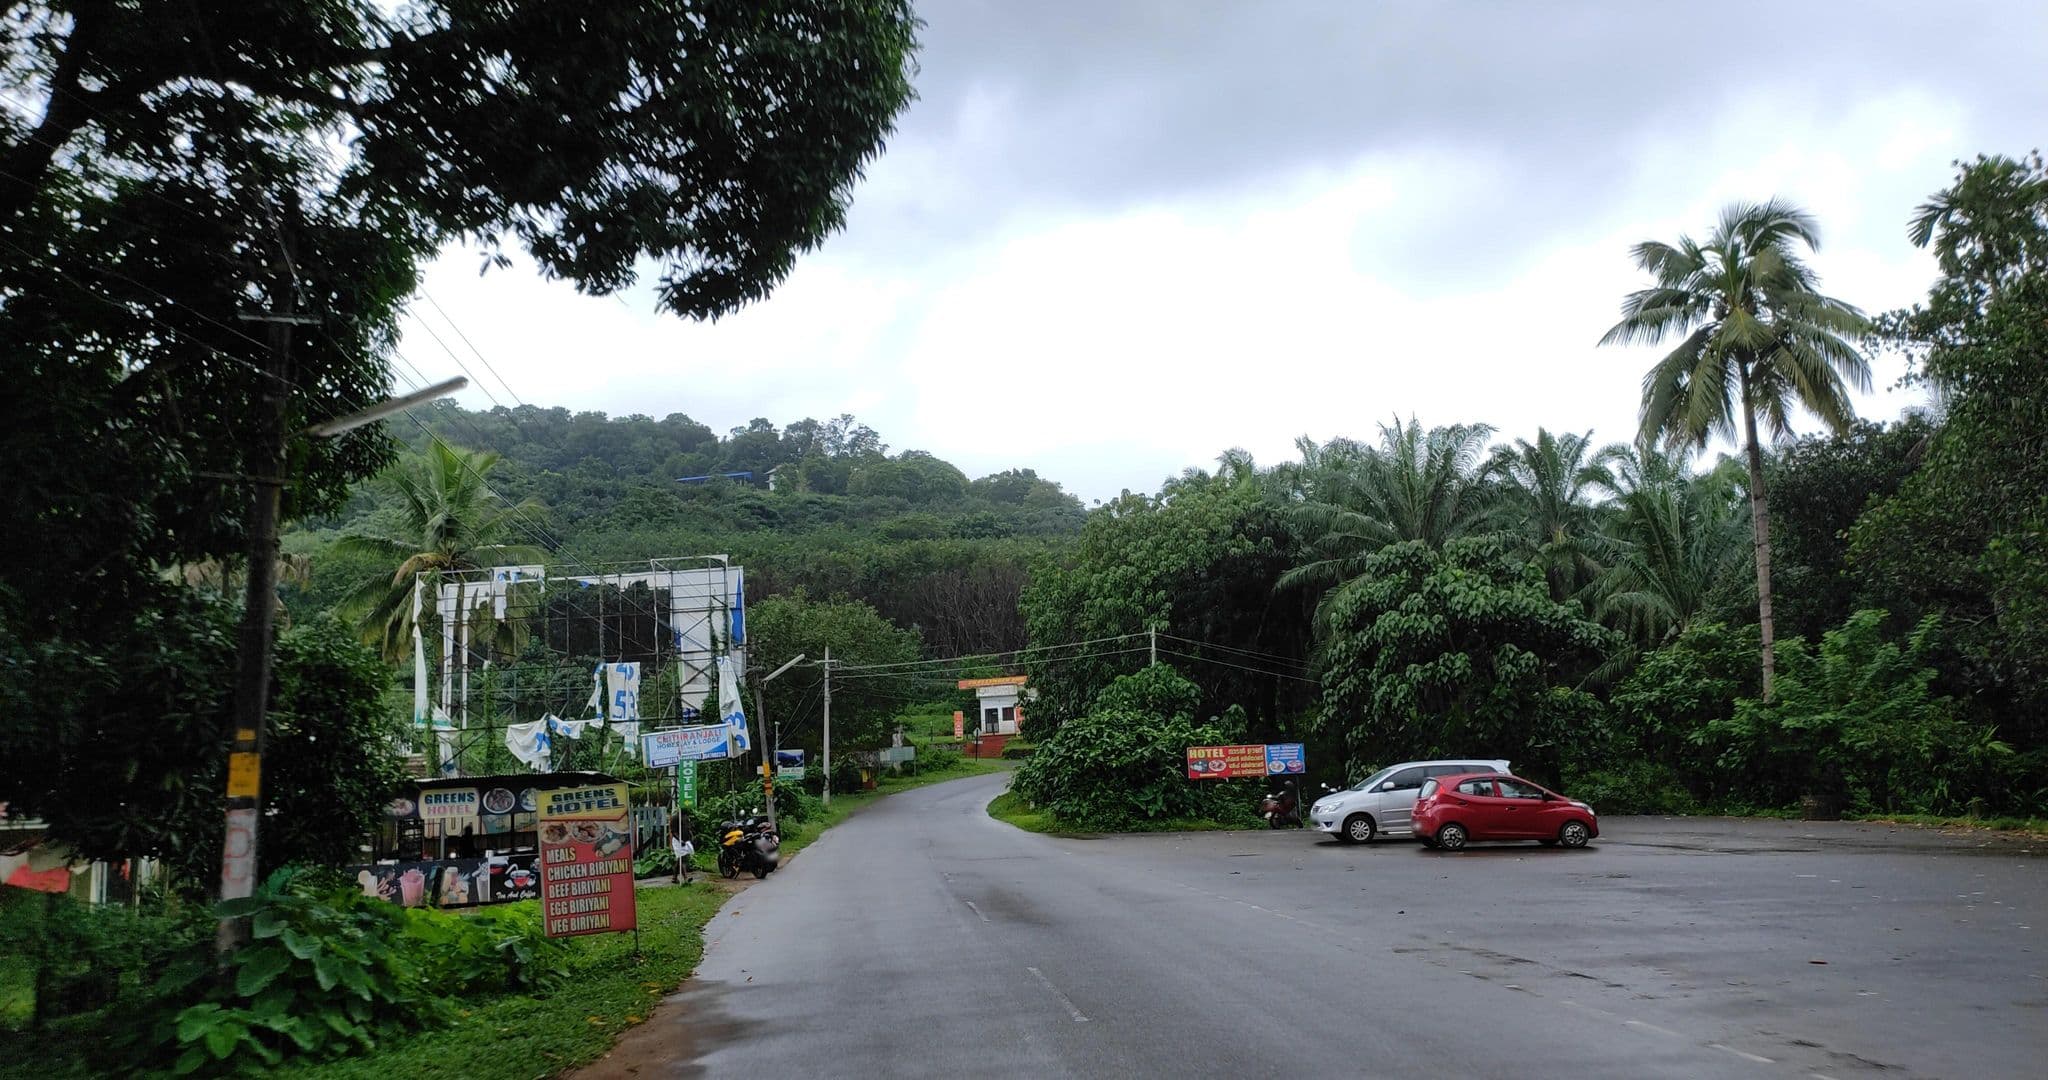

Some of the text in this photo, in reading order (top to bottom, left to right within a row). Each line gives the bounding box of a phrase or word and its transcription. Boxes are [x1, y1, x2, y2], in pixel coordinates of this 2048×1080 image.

[698, 736, 720, 745] LODGE
[1189, 748, 1225, 758] HOTEL
[682, 760, 693, 798] HOTEL
[424, 792, 475, 804] GREENS
[551, 787, 616, 803] GREENS
[426, 804, 471, 815] HOTEL
[546, 798, 625, 815] HOTEL
[546, 847, 576, 864] MEALS
[547, 858, 629, 881] CHICKEN BIRIYANI
[548, 878, 611, 898] BEEF BIRIYANI
[549, 896, 609, 916] EGG BIRIYANI
[550, 913, 610, 934] VEG BIRIYANI
